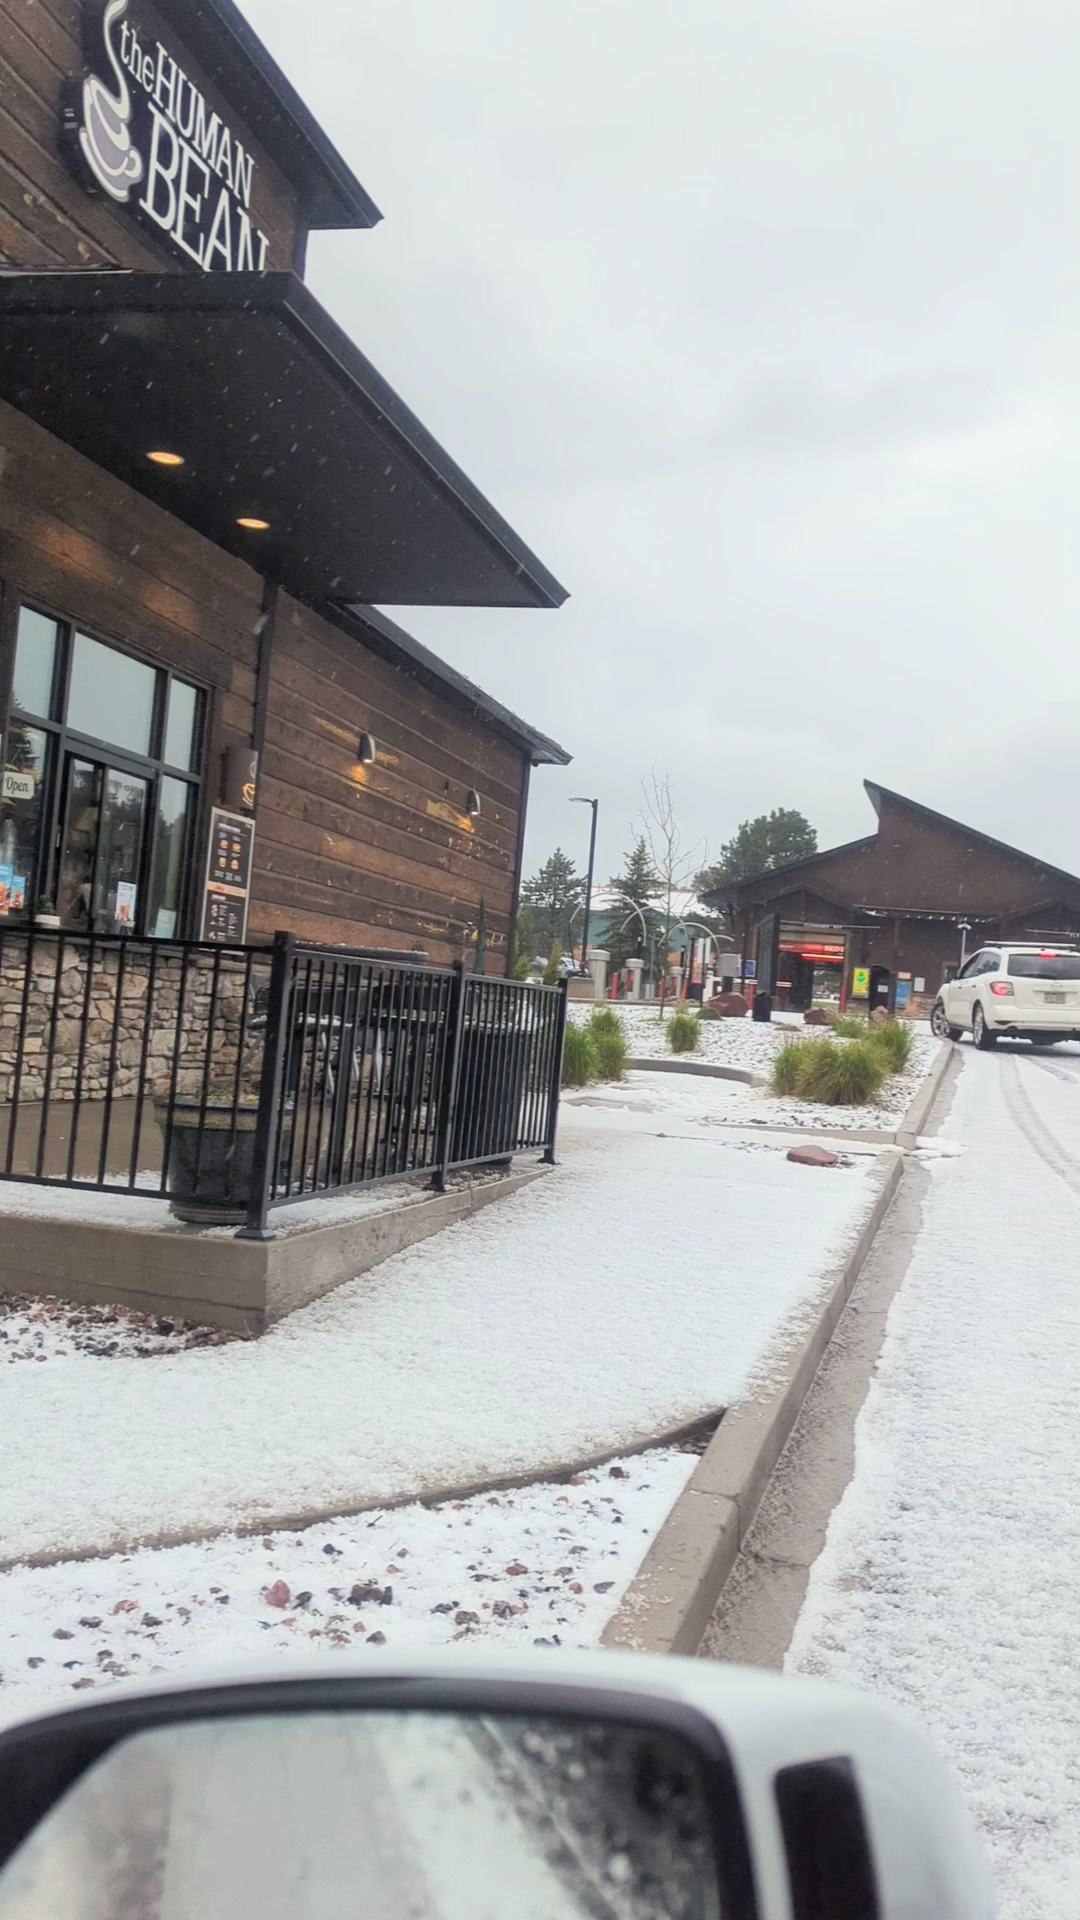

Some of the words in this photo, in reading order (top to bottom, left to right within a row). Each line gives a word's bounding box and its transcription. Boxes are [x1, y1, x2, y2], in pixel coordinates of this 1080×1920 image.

[120, 20, 154, 92] the
[152, 41, 254, 208] HUMAN
[138, 101, 269, 272] BEAN
[5, 776, 28, 795] Open
